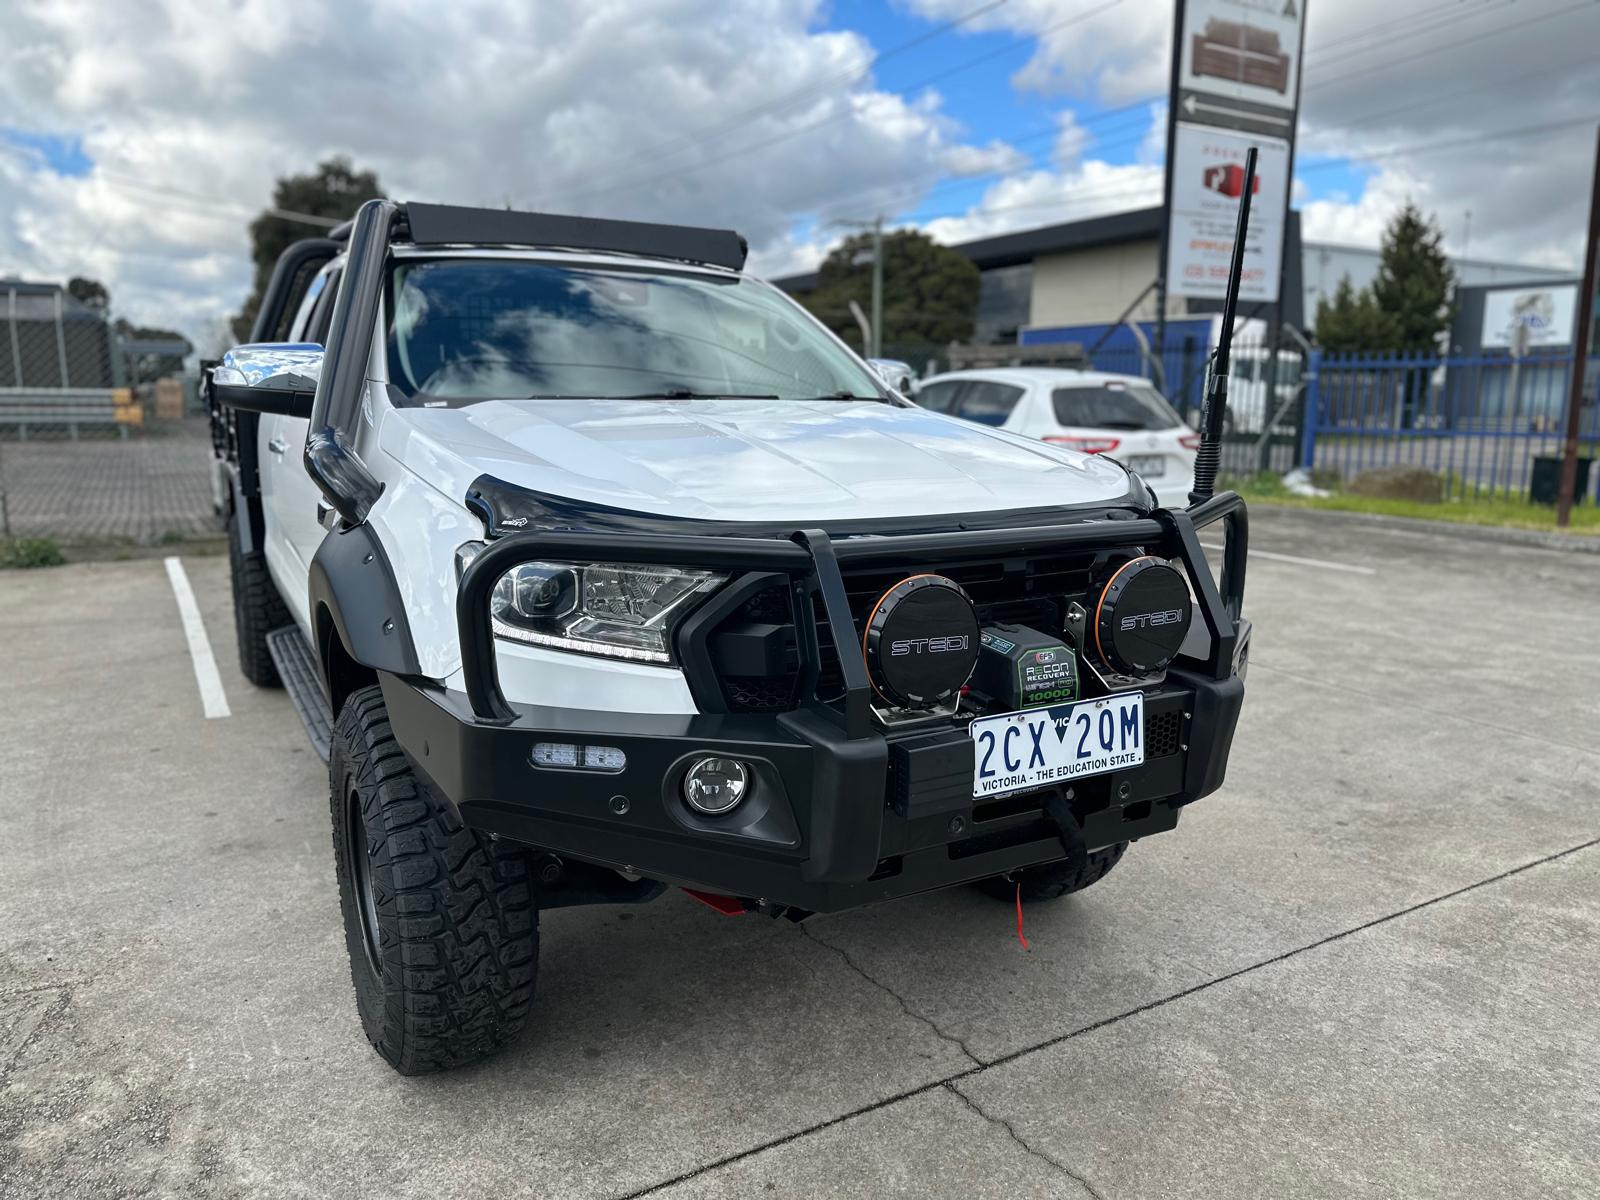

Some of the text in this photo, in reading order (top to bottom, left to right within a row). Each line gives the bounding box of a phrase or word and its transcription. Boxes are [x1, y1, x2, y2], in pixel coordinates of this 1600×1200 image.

[1121, 609, 1182, 631] STEDI
[891, 635, 969, 656] STEDI
[1026, 670, 1070, 682] RECOVERY
[1028, 688, 1071, 701] 10000
[1052, 717, 1070, 728] VIC
[978, 704, 1139, 779] 2CX 2QM
[982, 775, 1027, 792] VICTORIA
[1036, 768, 1054, 781] THE
[1057, 759, 1108, 777] EDUCATION
[1110, 752, 1136, 766] STATE
